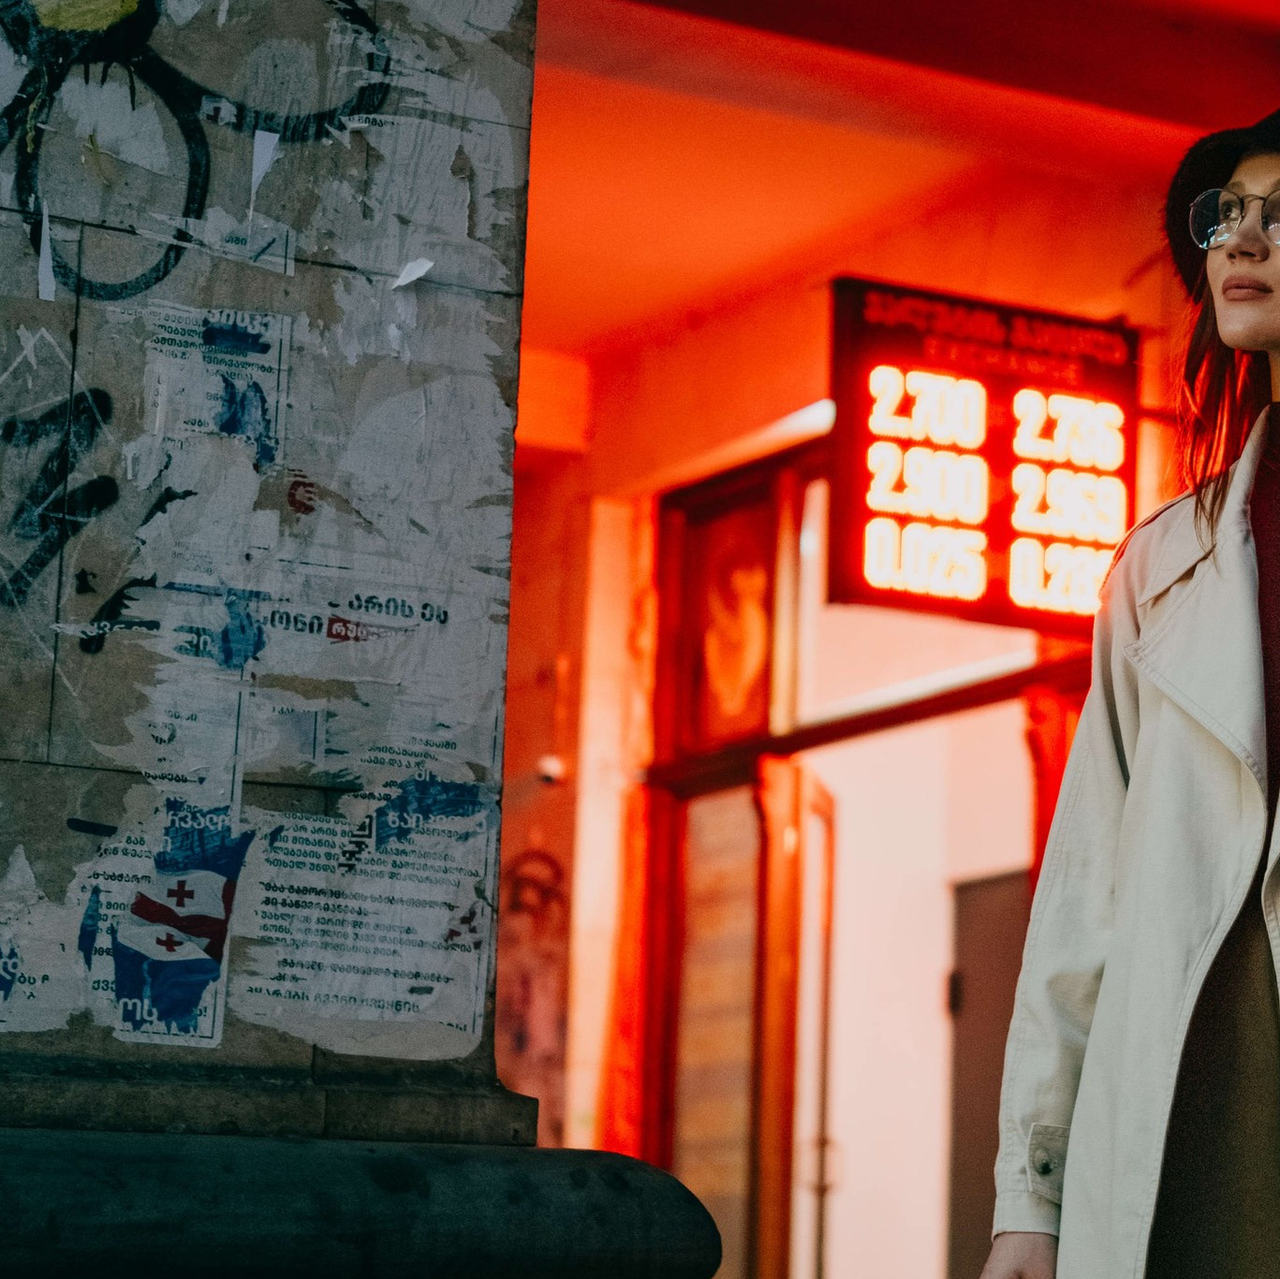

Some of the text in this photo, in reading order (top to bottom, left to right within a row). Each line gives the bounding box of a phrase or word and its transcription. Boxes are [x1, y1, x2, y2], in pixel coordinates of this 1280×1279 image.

[868, 364, 988, 450] 2.700
[866, 439, 989, 526] 2.900
[348, 594, 449, 625] არის ეს
[309, 863, 336, 875] უნდა
